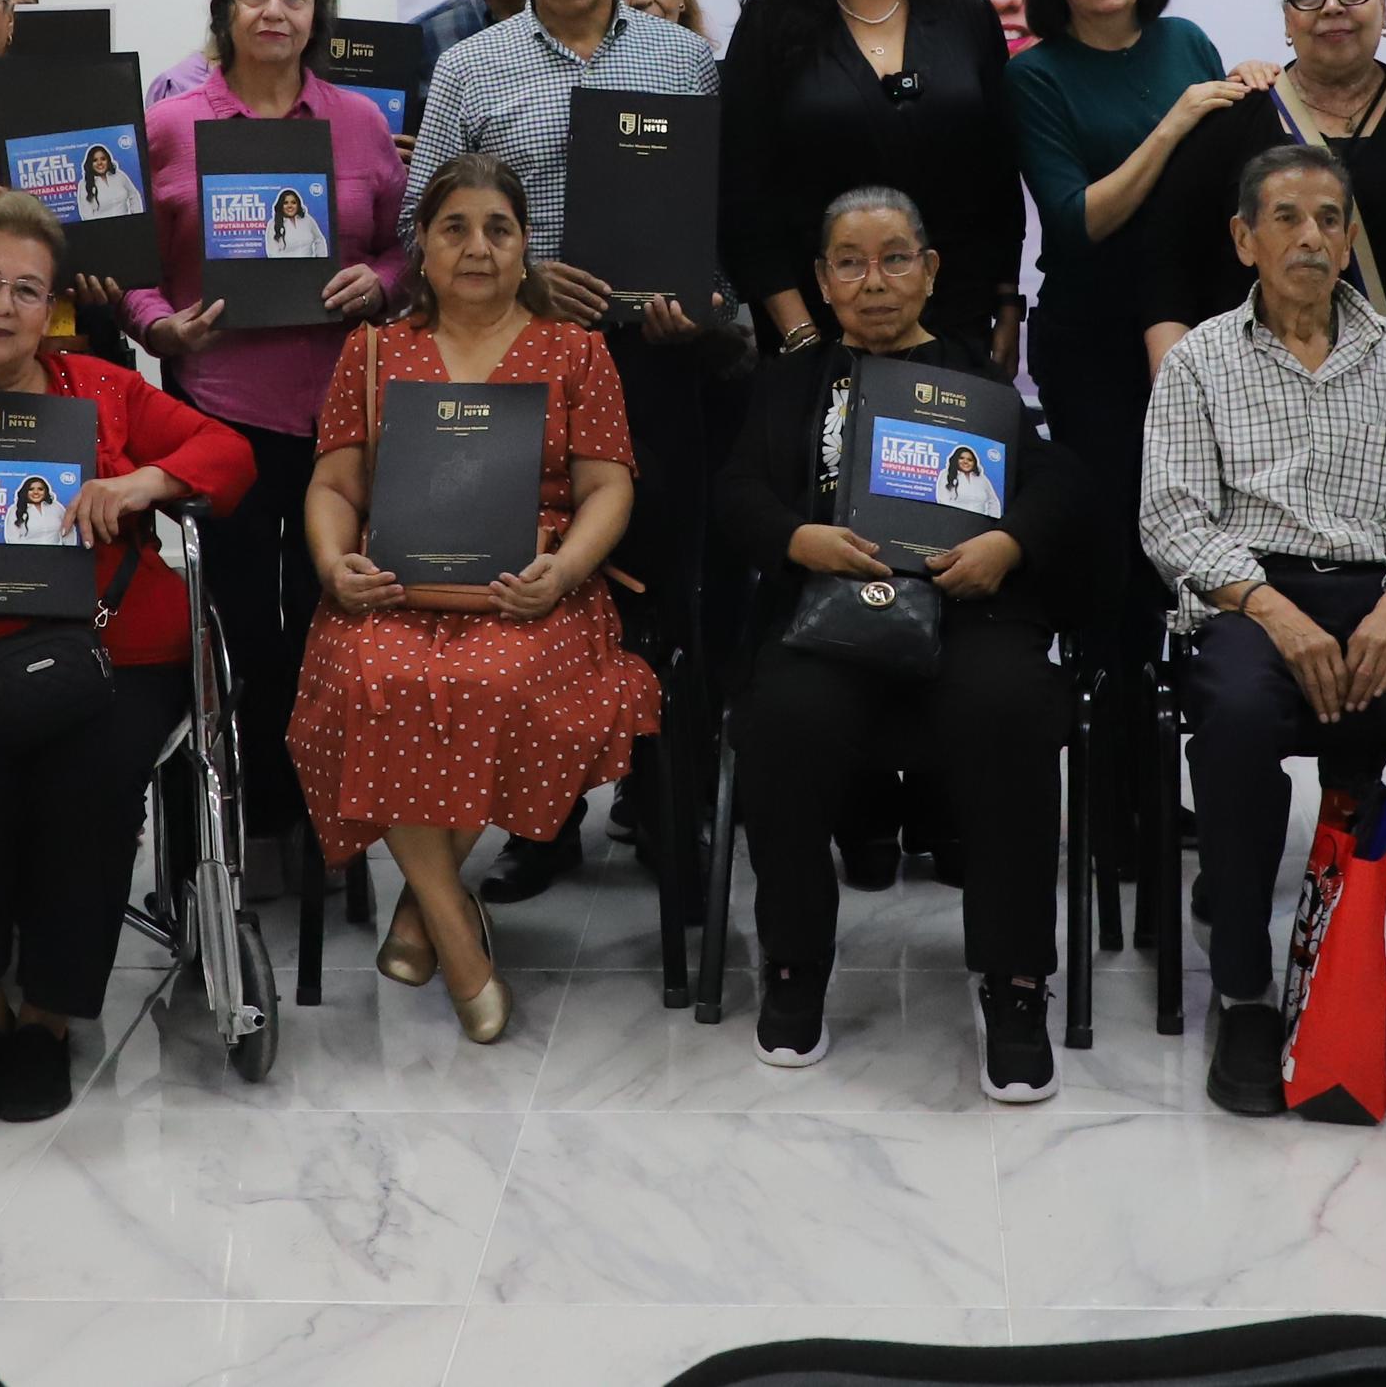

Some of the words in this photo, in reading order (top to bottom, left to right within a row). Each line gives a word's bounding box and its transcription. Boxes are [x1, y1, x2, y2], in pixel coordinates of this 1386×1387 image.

[17, 154, 75, 174] ITZEL
[20, 168, 76, 189] CASTILLO
[211, 194, 265, 207] ITZEL
[213, 207, 266, 222] CASTILLO
[882, 437, 940, 456] ITZEL
[881, 448, 940, 469] CASTILLO
